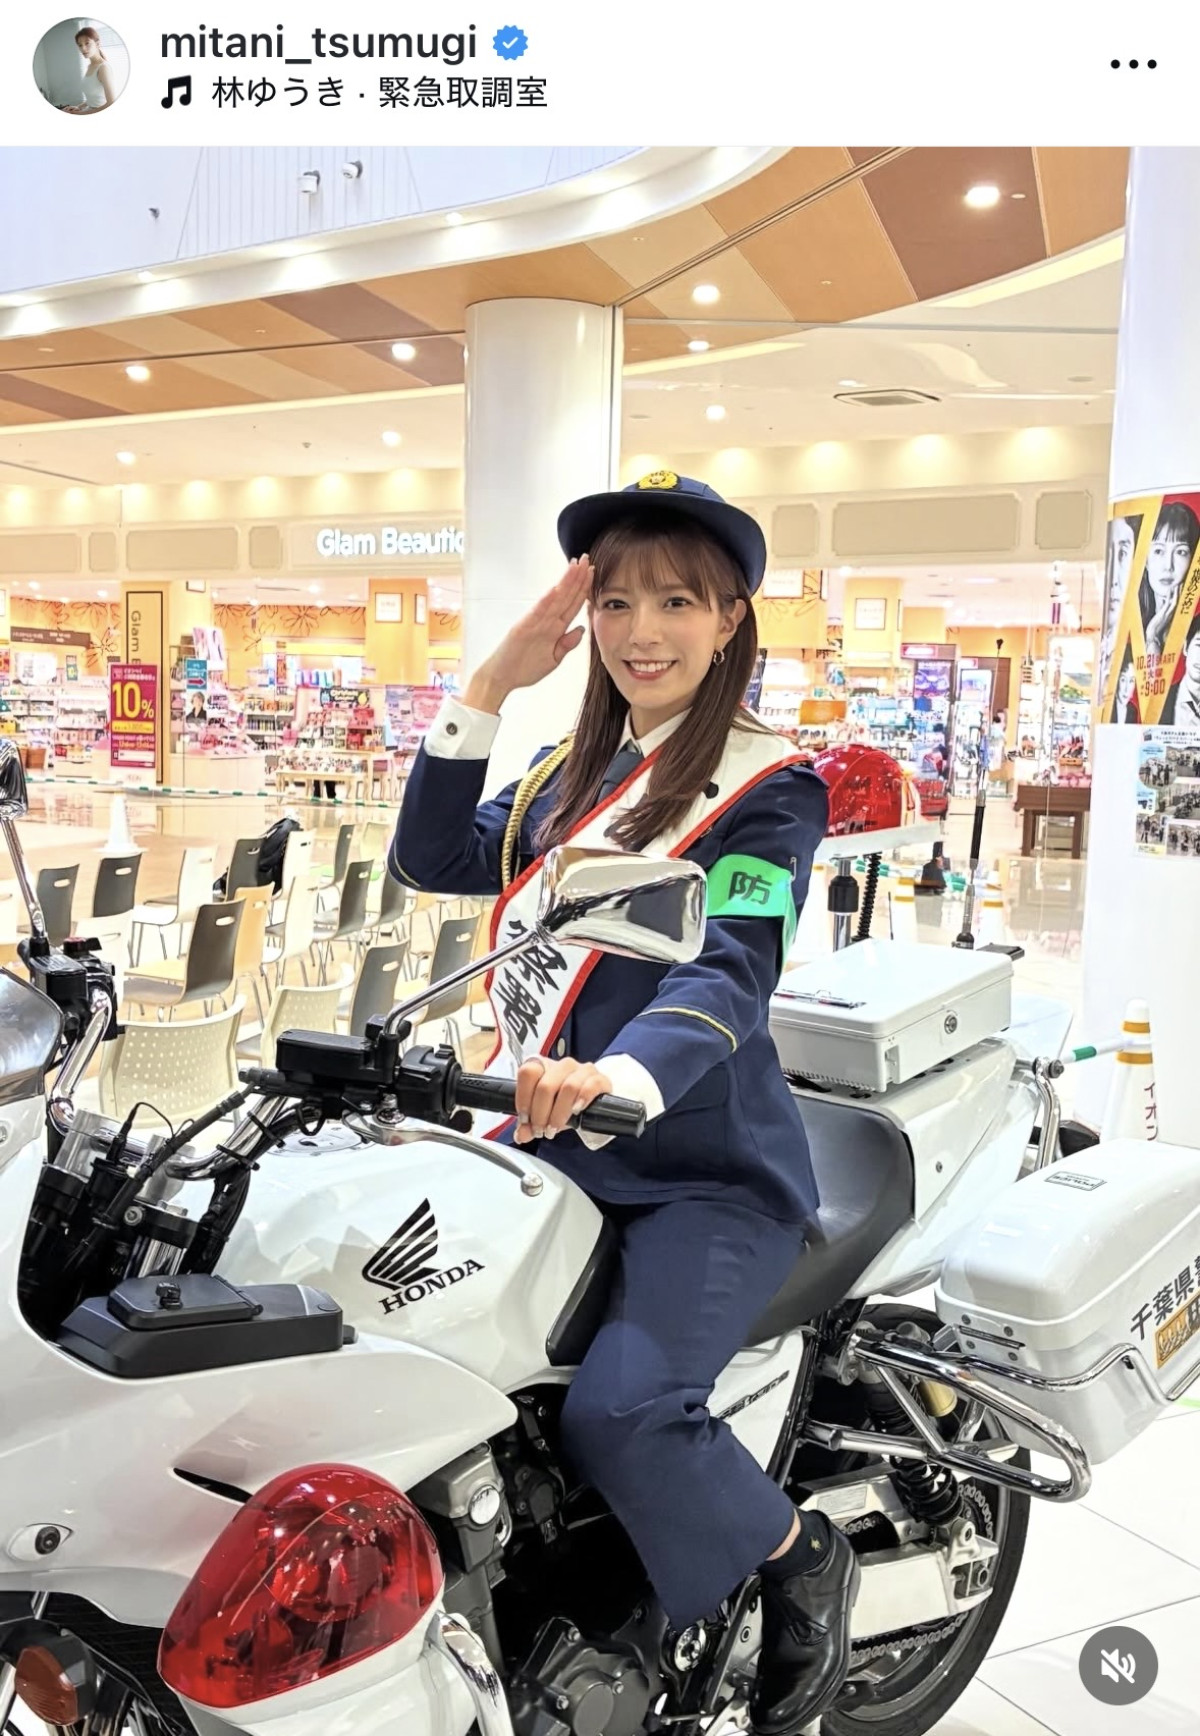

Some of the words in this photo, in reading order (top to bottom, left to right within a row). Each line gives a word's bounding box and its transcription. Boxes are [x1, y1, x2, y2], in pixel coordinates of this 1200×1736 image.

[316, 528, 376, 556] Glam
[131, 610, 141, 652] Glam
[112, 681, 154, 719] 10%
[728, 871, 772, 905] 防
[1144, 1082, 1158, 1141] イオン
[378, 1259, 486, 1315] HONDA
[1130, 1256, 1200, 1340] 千葉県
